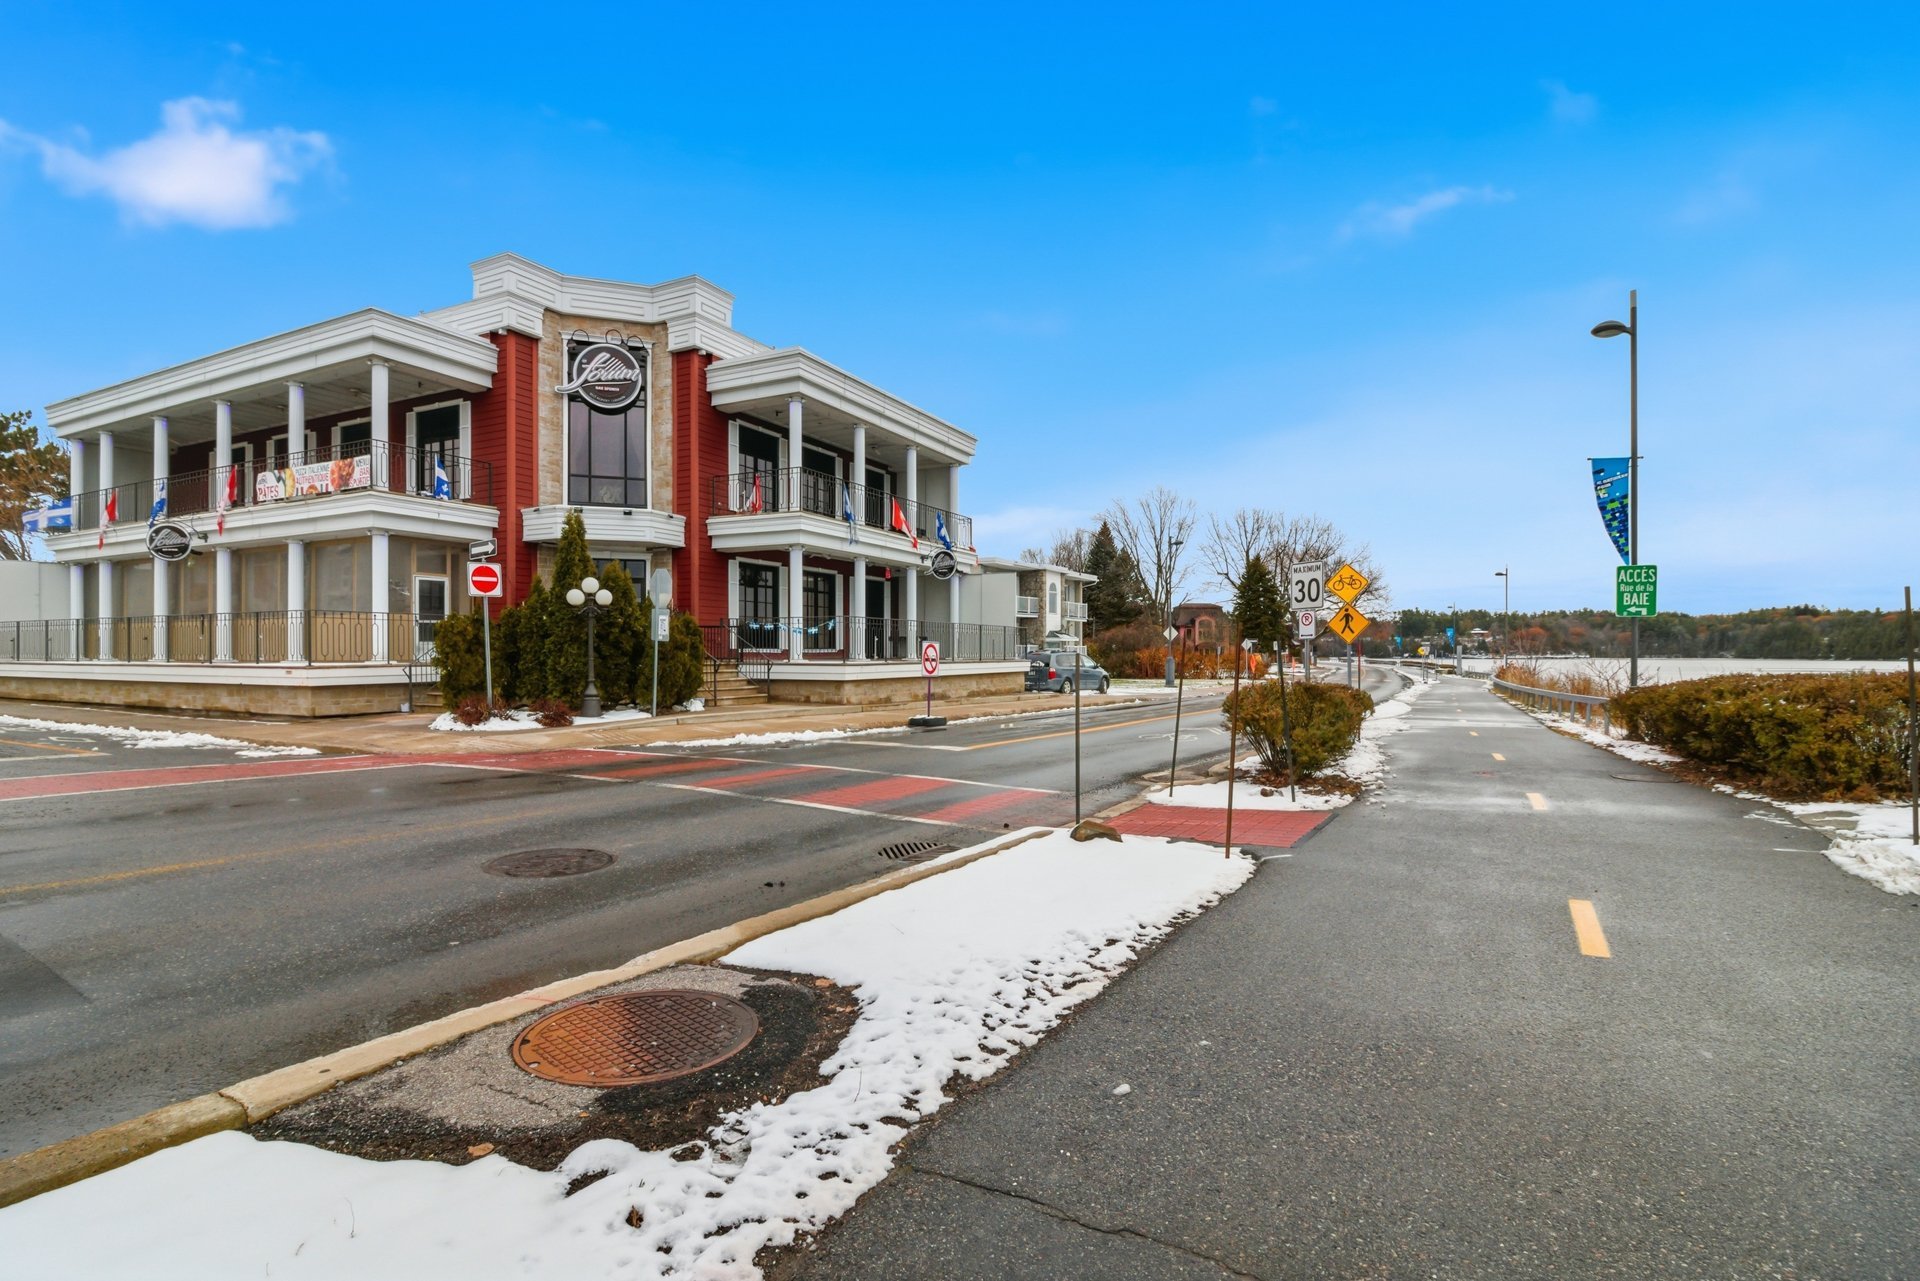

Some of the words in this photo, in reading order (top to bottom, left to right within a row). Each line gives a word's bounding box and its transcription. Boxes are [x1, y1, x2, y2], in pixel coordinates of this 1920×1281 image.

[1293, 565, 1321, 574] MAXIMUM
[1294, 578, 1320, 603] 30
[1619, 583, 1634, 592] Rue
[1635, 583, 1645, 592] de
[1646, 583, 1654, 592] la
[1623, 592, 1650, 606] BAIE
